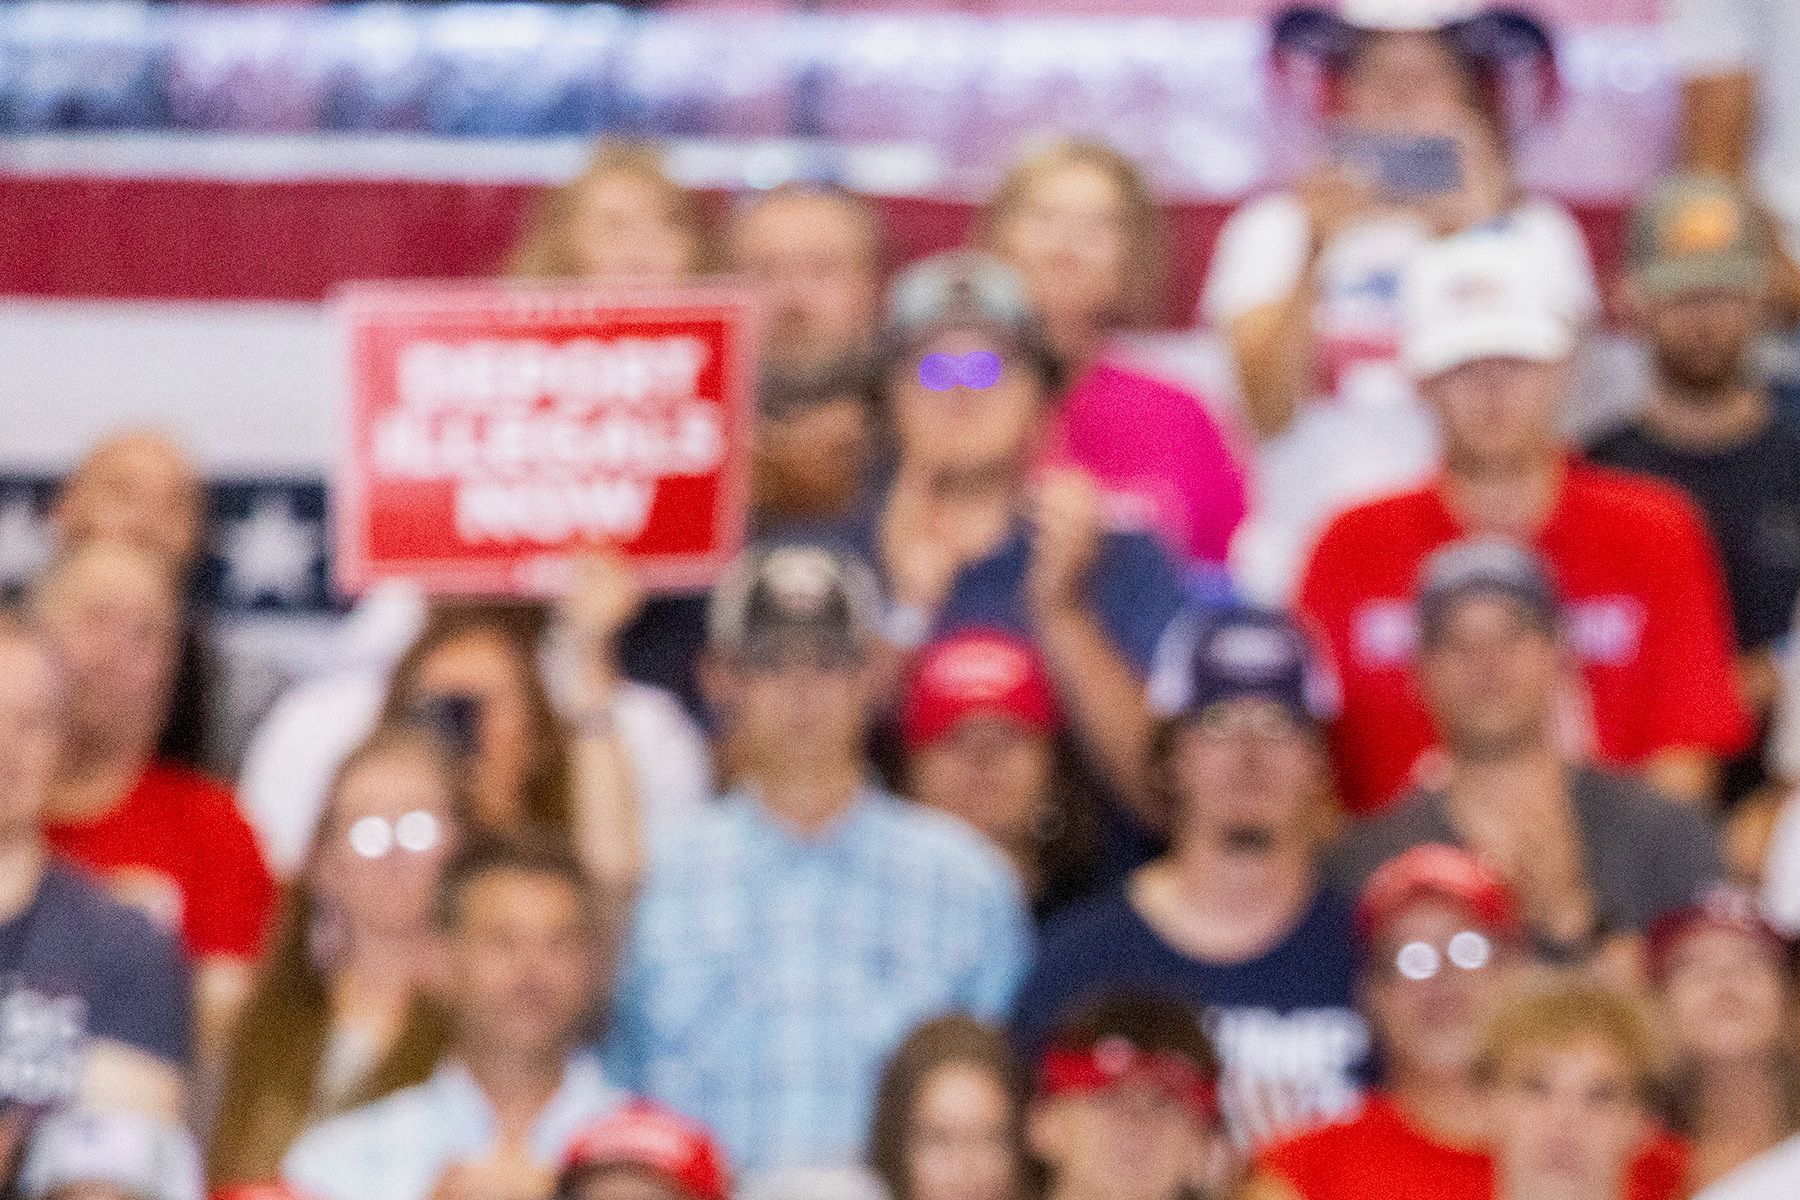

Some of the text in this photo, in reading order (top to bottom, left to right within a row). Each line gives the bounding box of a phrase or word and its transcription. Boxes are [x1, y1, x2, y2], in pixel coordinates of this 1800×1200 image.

[397, 334, 709, 408] DEPORT
[372, 400, 724, 477] ILLEGALS
[455, 476, 656, 545] NOW
